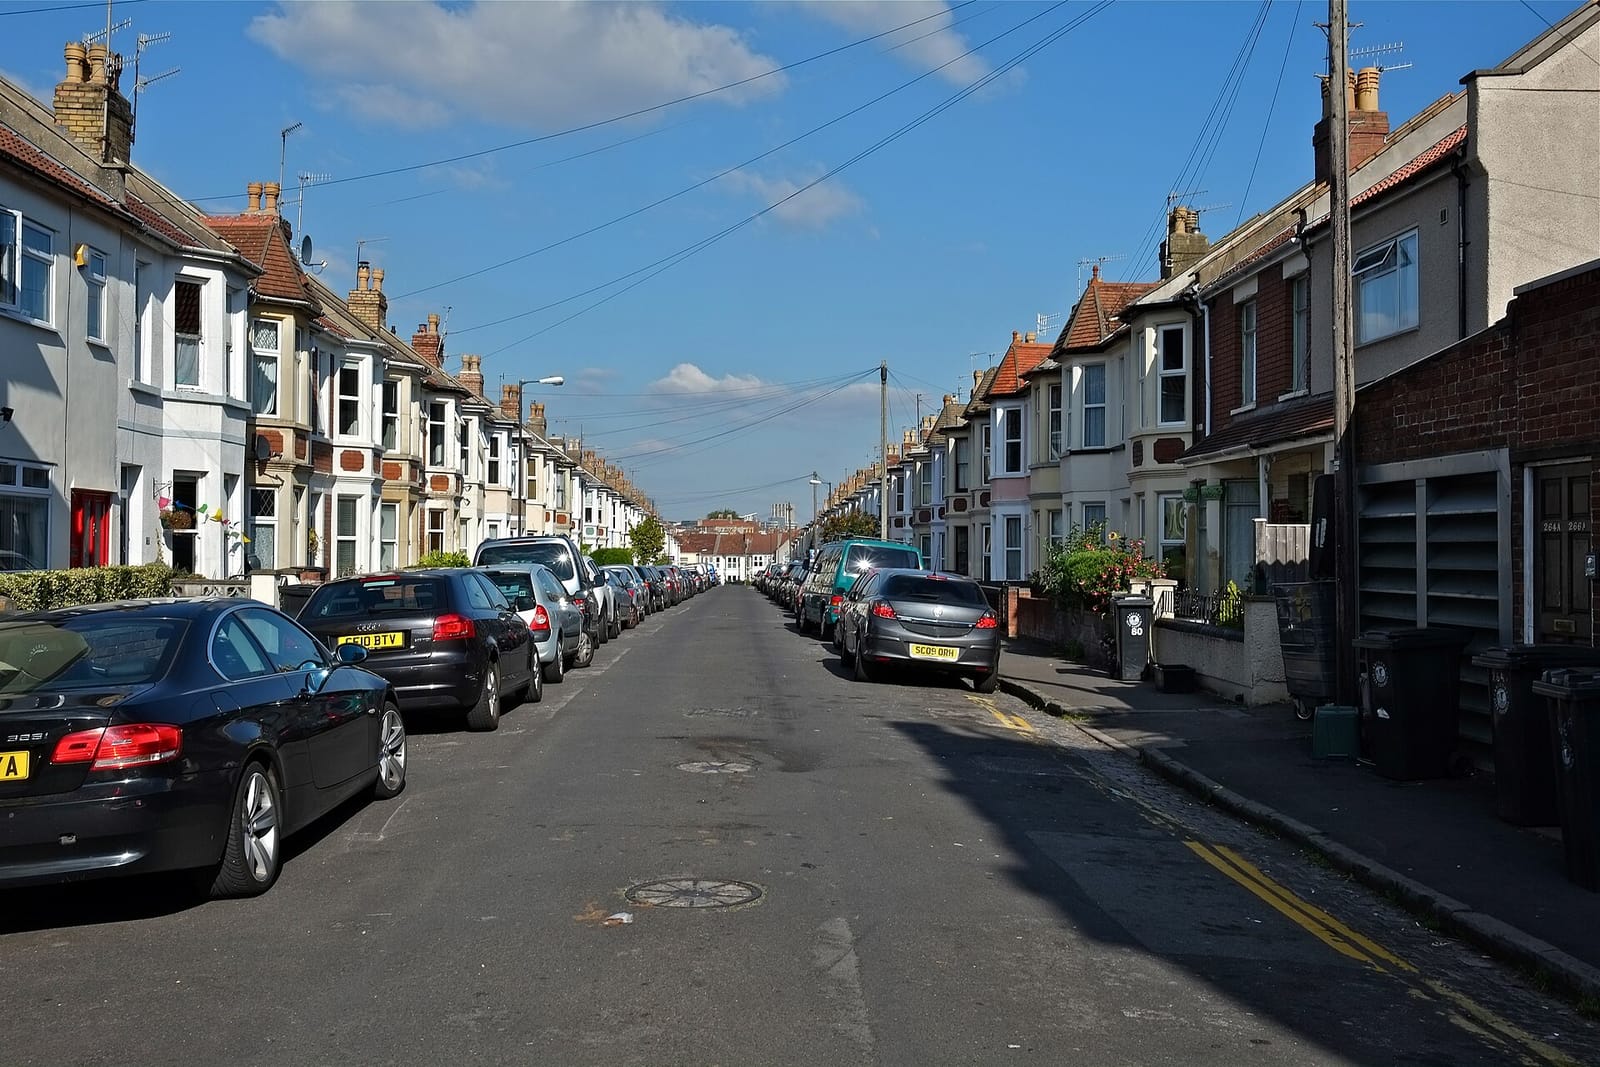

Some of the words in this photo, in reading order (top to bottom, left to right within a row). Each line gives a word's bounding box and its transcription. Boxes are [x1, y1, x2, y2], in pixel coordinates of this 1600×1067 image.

[1131, 628, 1143, 636] 80
[374, 634, 396, 646] BTV
[915, 646, 937, 655] SC09
